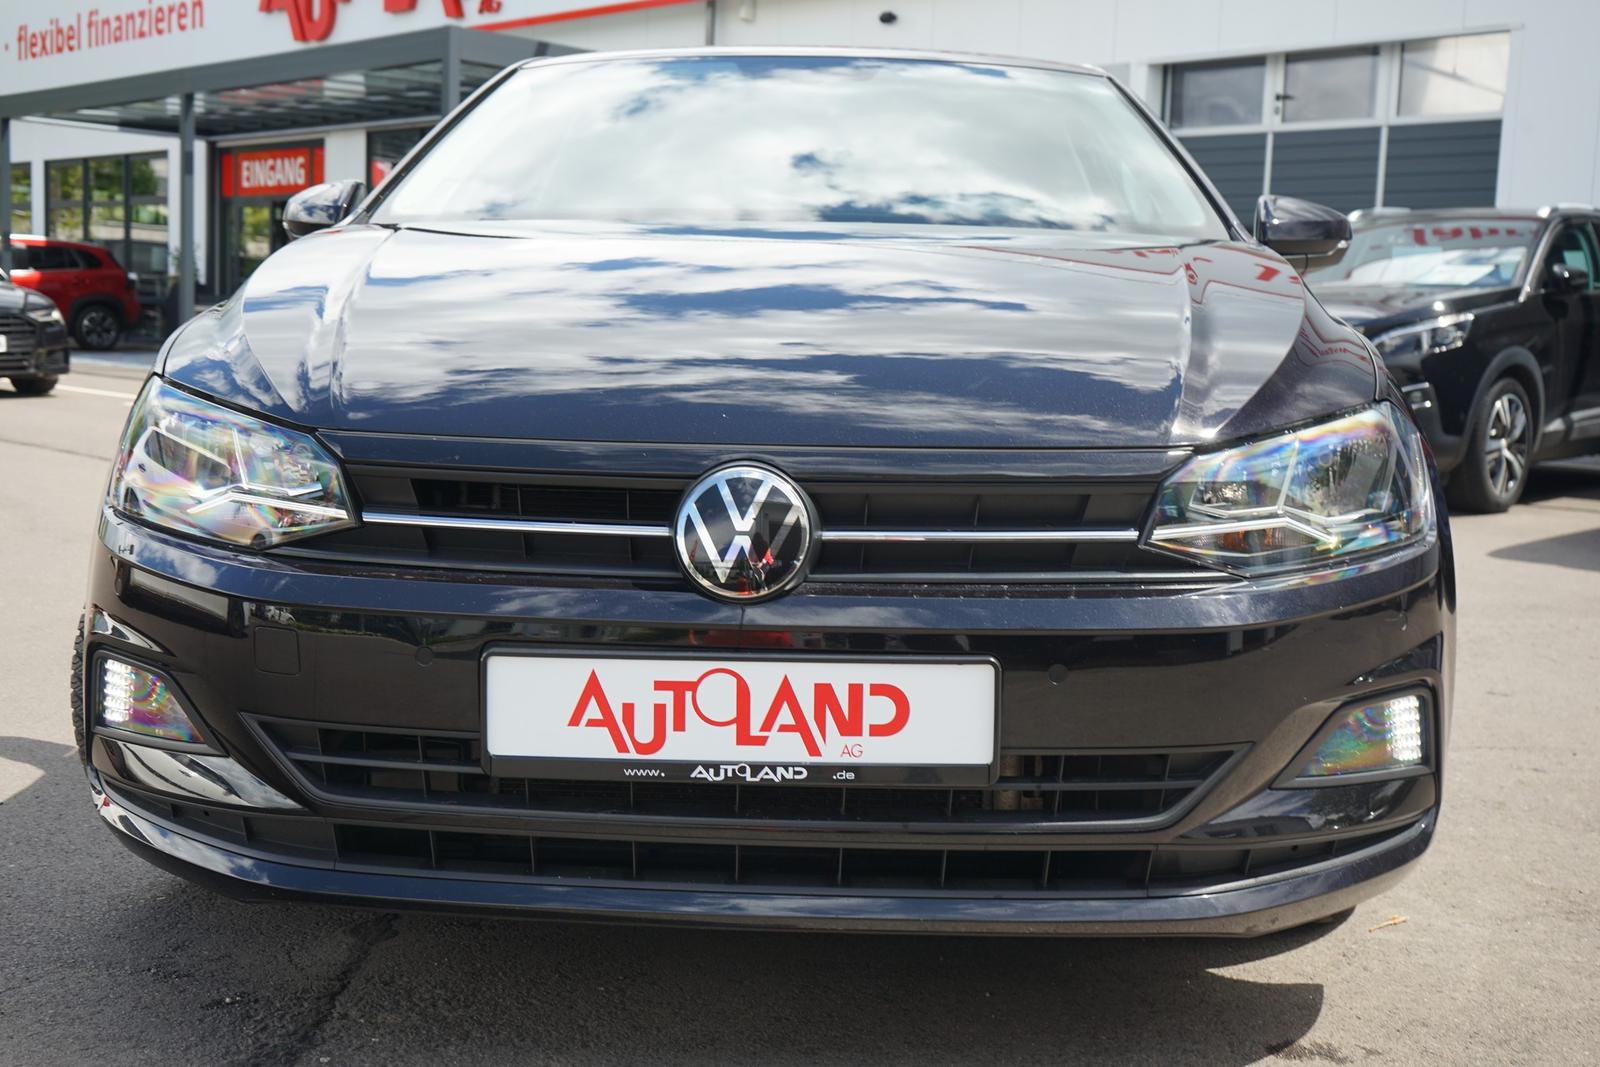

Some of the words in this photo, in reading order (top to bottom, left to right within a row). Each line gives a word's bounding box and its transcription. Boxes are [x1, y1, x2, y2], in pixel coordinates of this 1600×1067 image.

[17, 13, 81, 60] flexibel
[87, 0, 205, 48] finanzieren
[241, 156, 306, 188] EINGANG
[567, 667, 911, 758] AUTOLAND
[839, 743, 863, 758] AG
